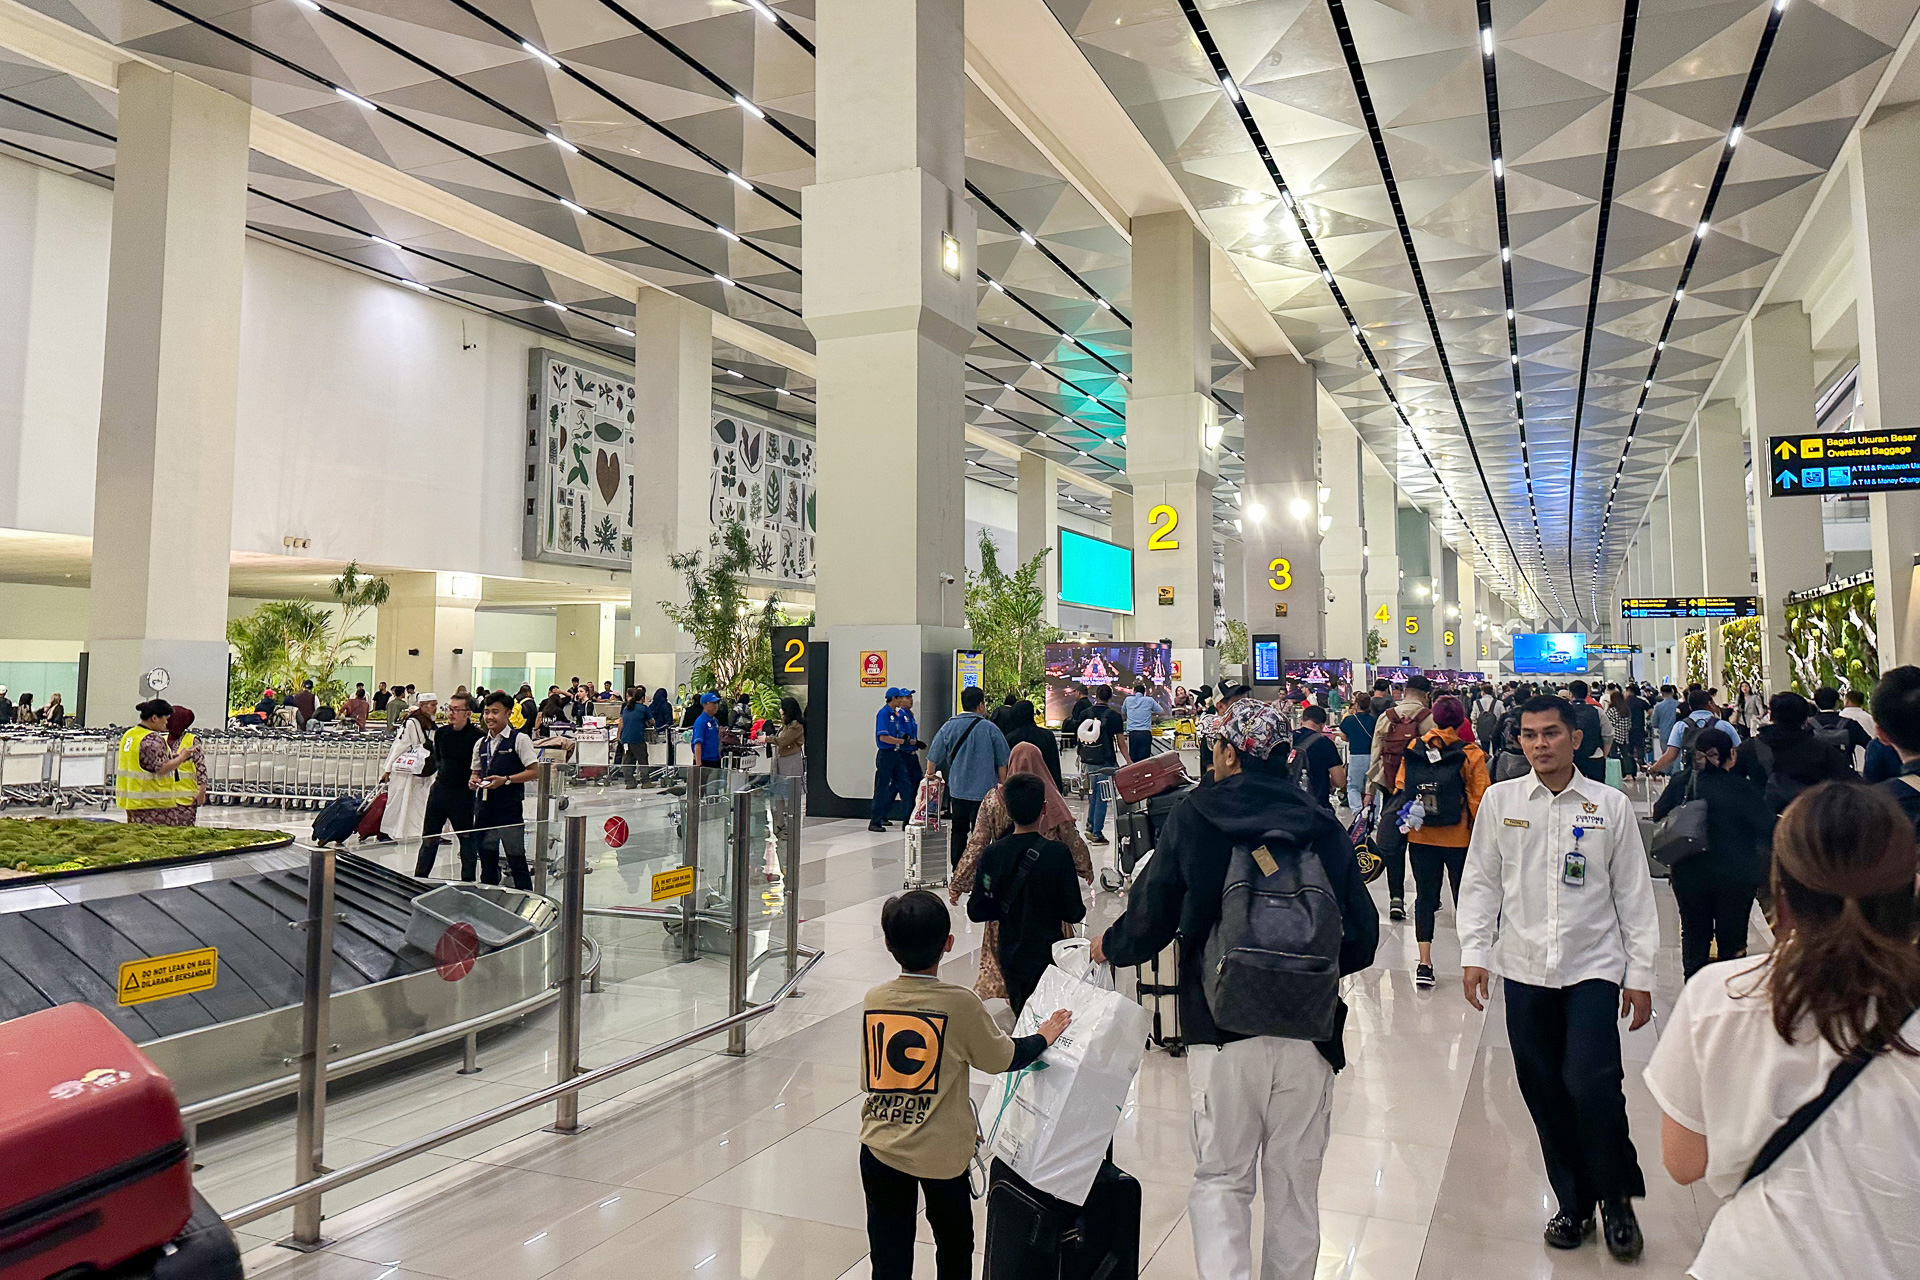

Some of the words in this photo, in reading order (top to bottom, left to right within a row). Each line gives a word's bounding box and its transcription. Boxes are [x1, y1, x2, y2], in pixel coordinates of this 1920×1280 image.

[1827, 438, 1856, 446] Bagasi
[1858, 436, 1889, 444] Ukuran
[1890, 434, 1917, 442] Besar
[1827, 448, 1870, 457] Oversized
[1872, 446, 1911, 456] Baggage
[1148, 504, 1179, 551] 2
[1268, 557, 1292, 591] 3
[1374, 603, 1391, 624] 4
[1405, 616, 1419, 635] 5
[1443, 630, 1455, 646] 6
[784, 638, 805, 673] 2
[141, 975, 174, 988] DILARANG
[174, 968, 212, 982] BERSANDAR
[142, 970, 152, 978] DO
[153, 967, 167, 975] NOT
[168, 963, 185, 973] LEAN
[186, 961, 196, 969] ON
[198, 959, 212, 967] RAIL
